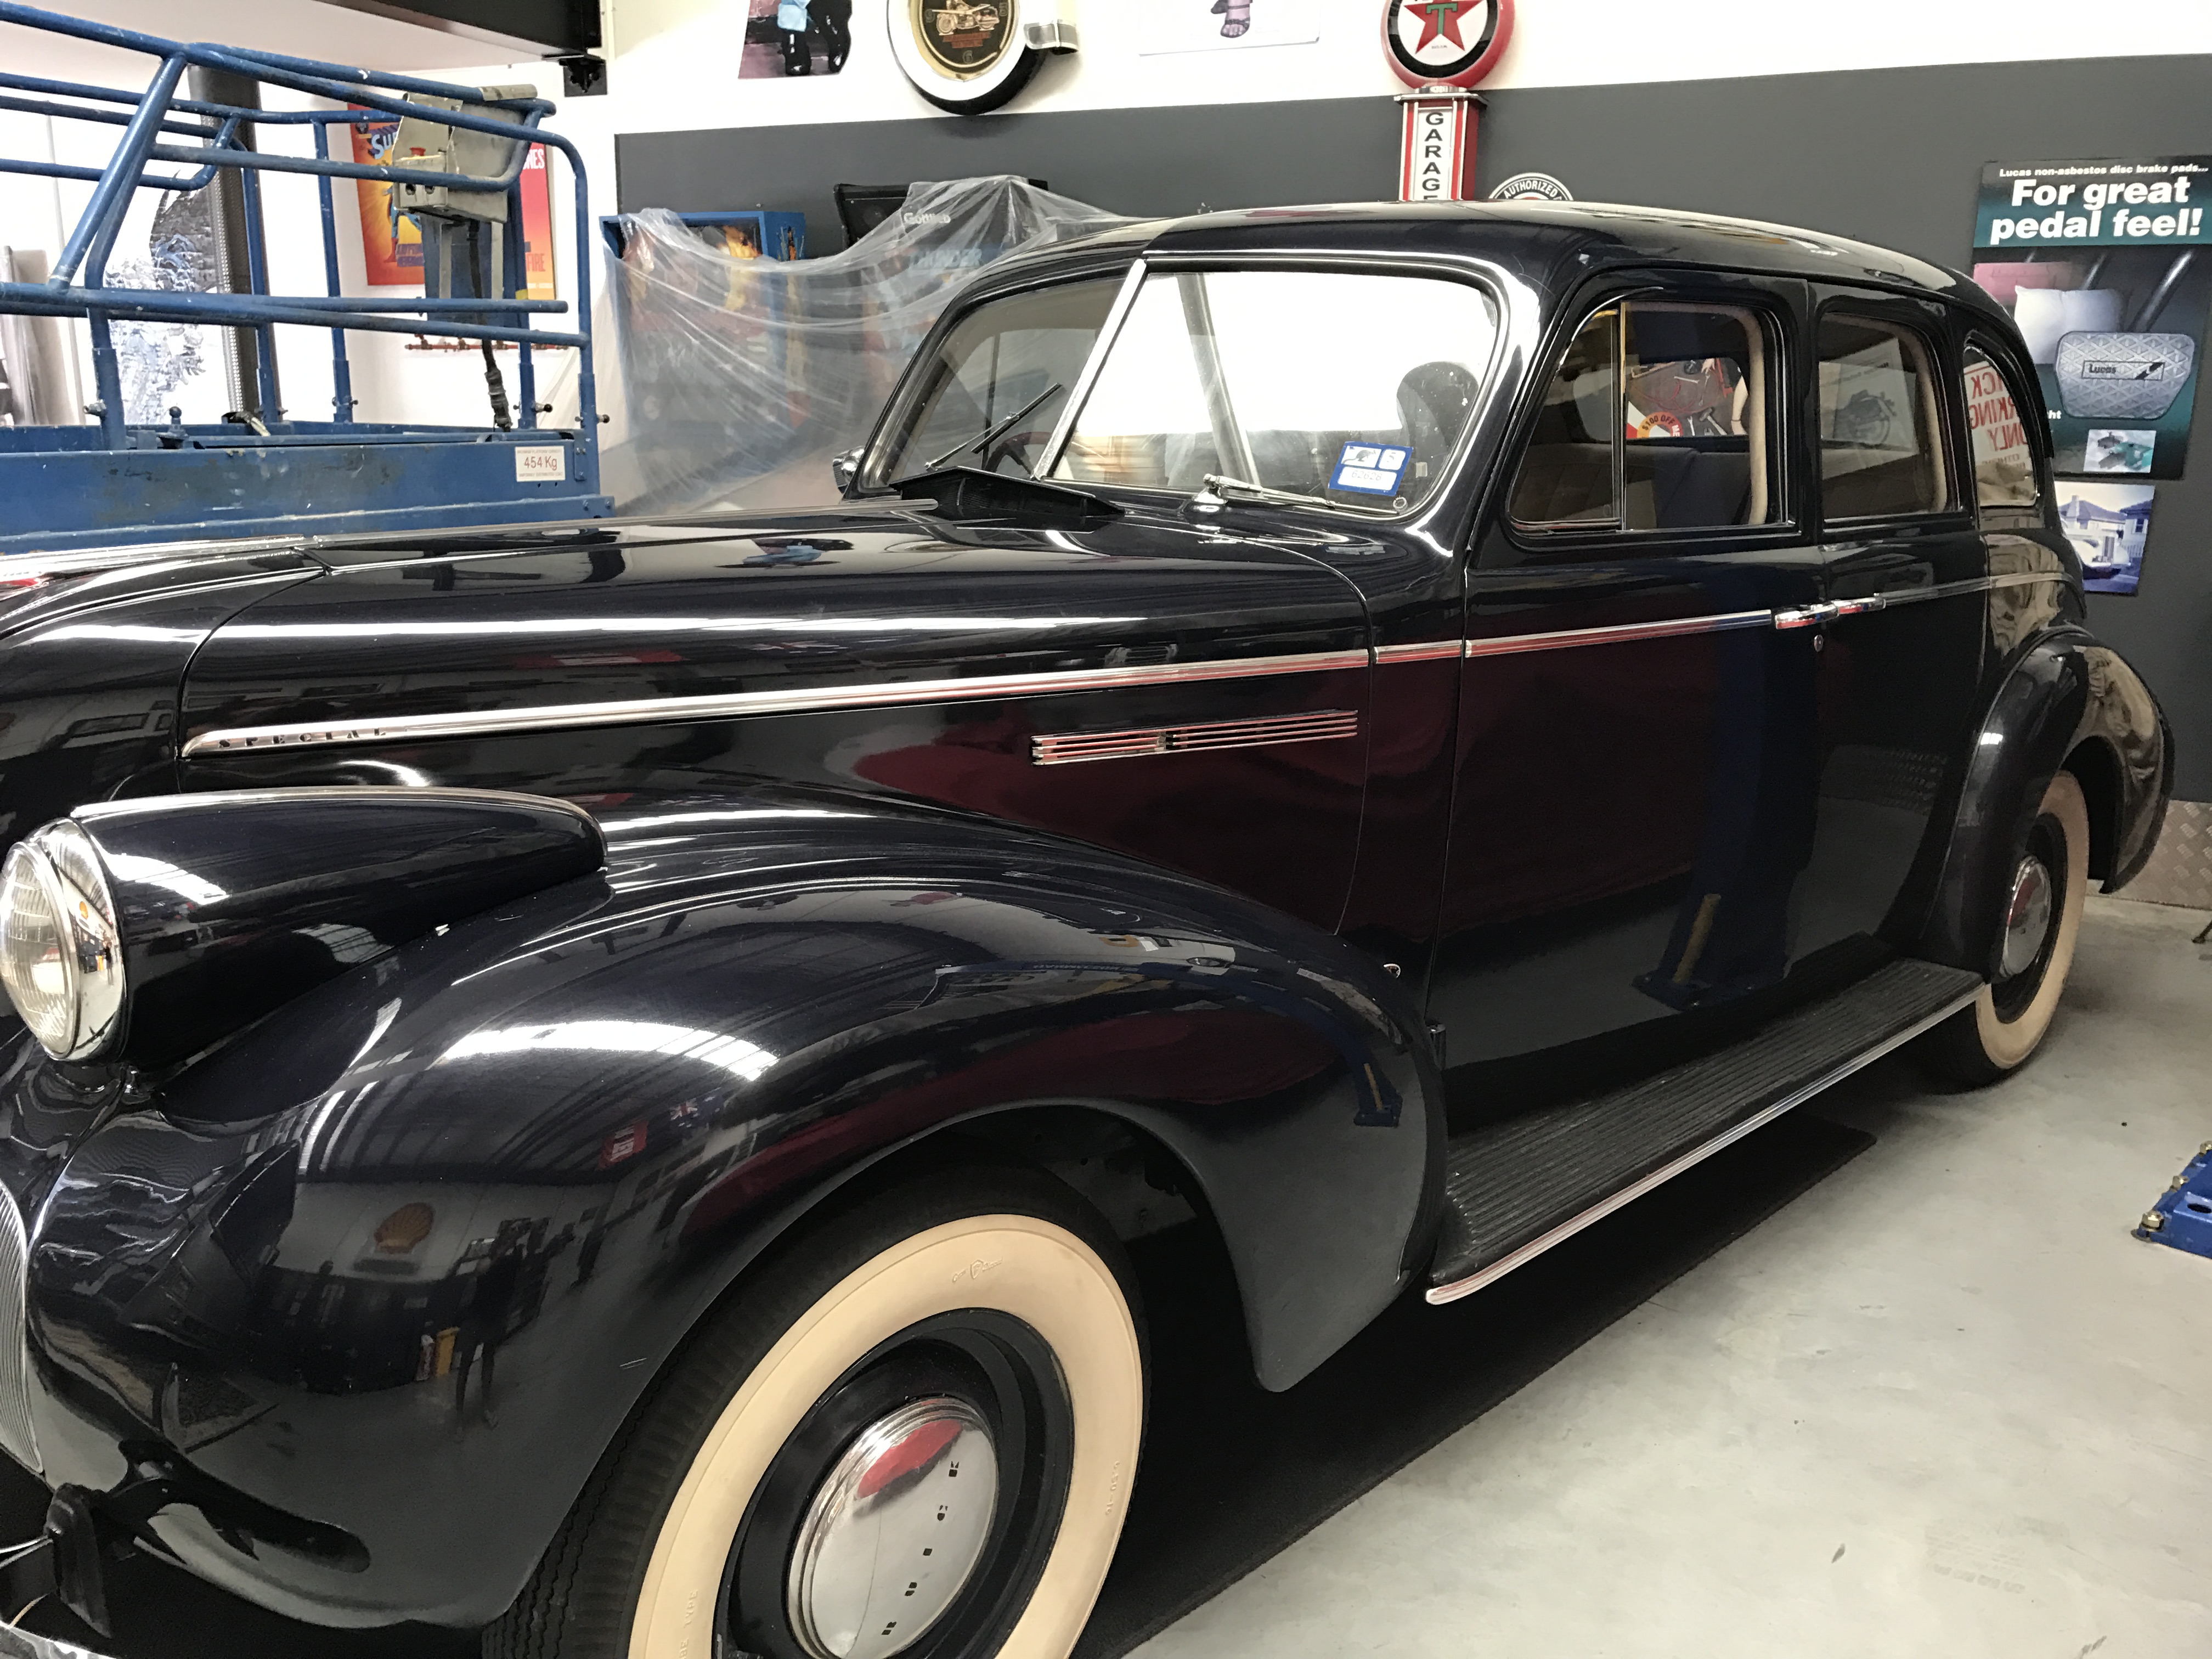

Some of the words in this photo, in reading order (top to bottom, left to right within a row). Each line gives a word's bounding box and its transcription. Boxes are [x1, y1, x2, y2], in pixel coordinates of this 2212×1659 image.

[1426, 3, 1458, 35] T
[1999, 168, 2032, 177] Lucas
[2034, 167, 2107, 176] non-asbestos
[2110, 165, 2133, 174] disc
[2136, 165, 2168, 173] brake
[1504, 180, 1558, 199] AUTHORIZED
[2011, 179, 2076, 207] For
[2083, 176, 2191, 211] great
[1990, 210, 2102, 245] pedal
[2112, 208, 2203, 237] feel!
[2089, 363, 2116, 374] Lucas
[1642, 415, 1658, 431] $100
[1661, 414, 1675, 425] OFF
[524, 456, 543, 469] 454
[545, 455, 557, 471] Kg
[1351, 470, 1383, 481] 62628
[218, 727, 386, 748] SPECIAL
